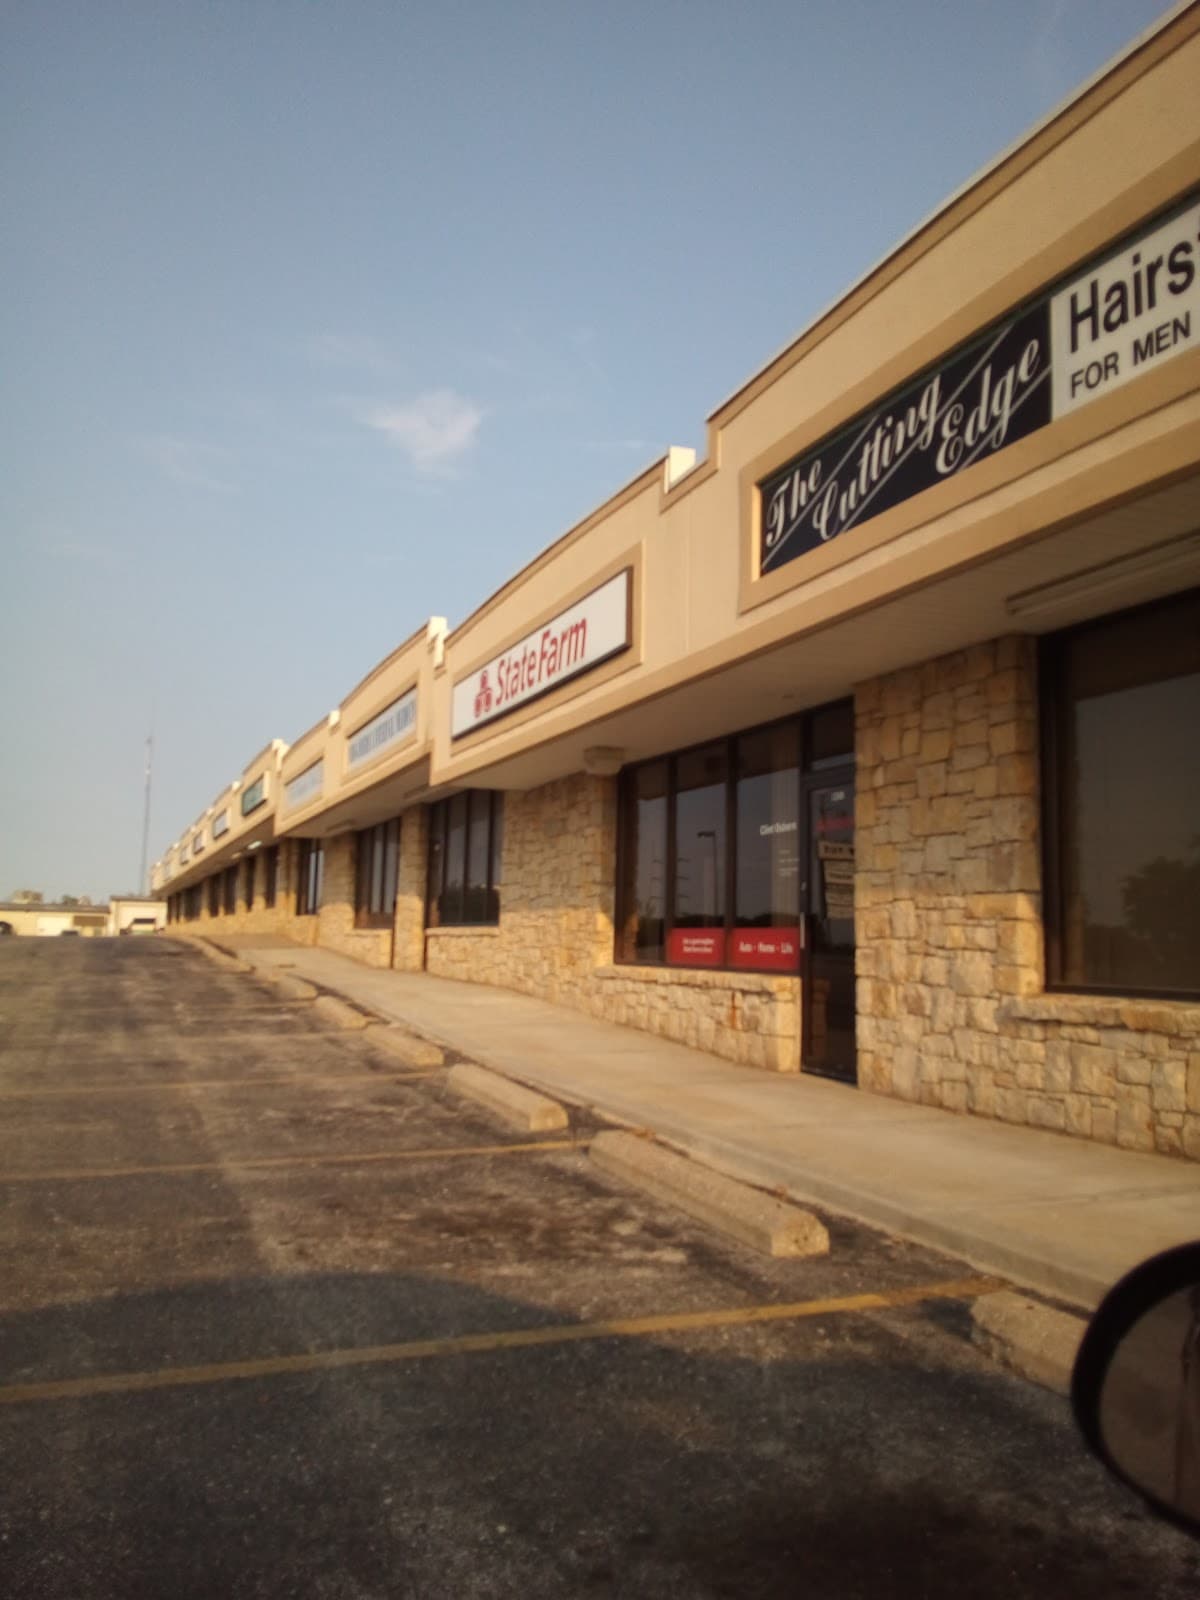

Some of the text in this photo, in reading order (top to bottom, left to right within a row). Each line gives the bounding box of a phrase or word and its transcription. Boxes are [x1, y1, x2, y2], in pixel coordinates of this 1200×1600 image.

[1070, 216, 1200, 354] Hairs
[936, 339, 1040, 475] Edge
[1070, 311, 1191, 399] FOR MEN
[766, 459, 822, 548] The
[812, 374, 942, 541] Cutting
